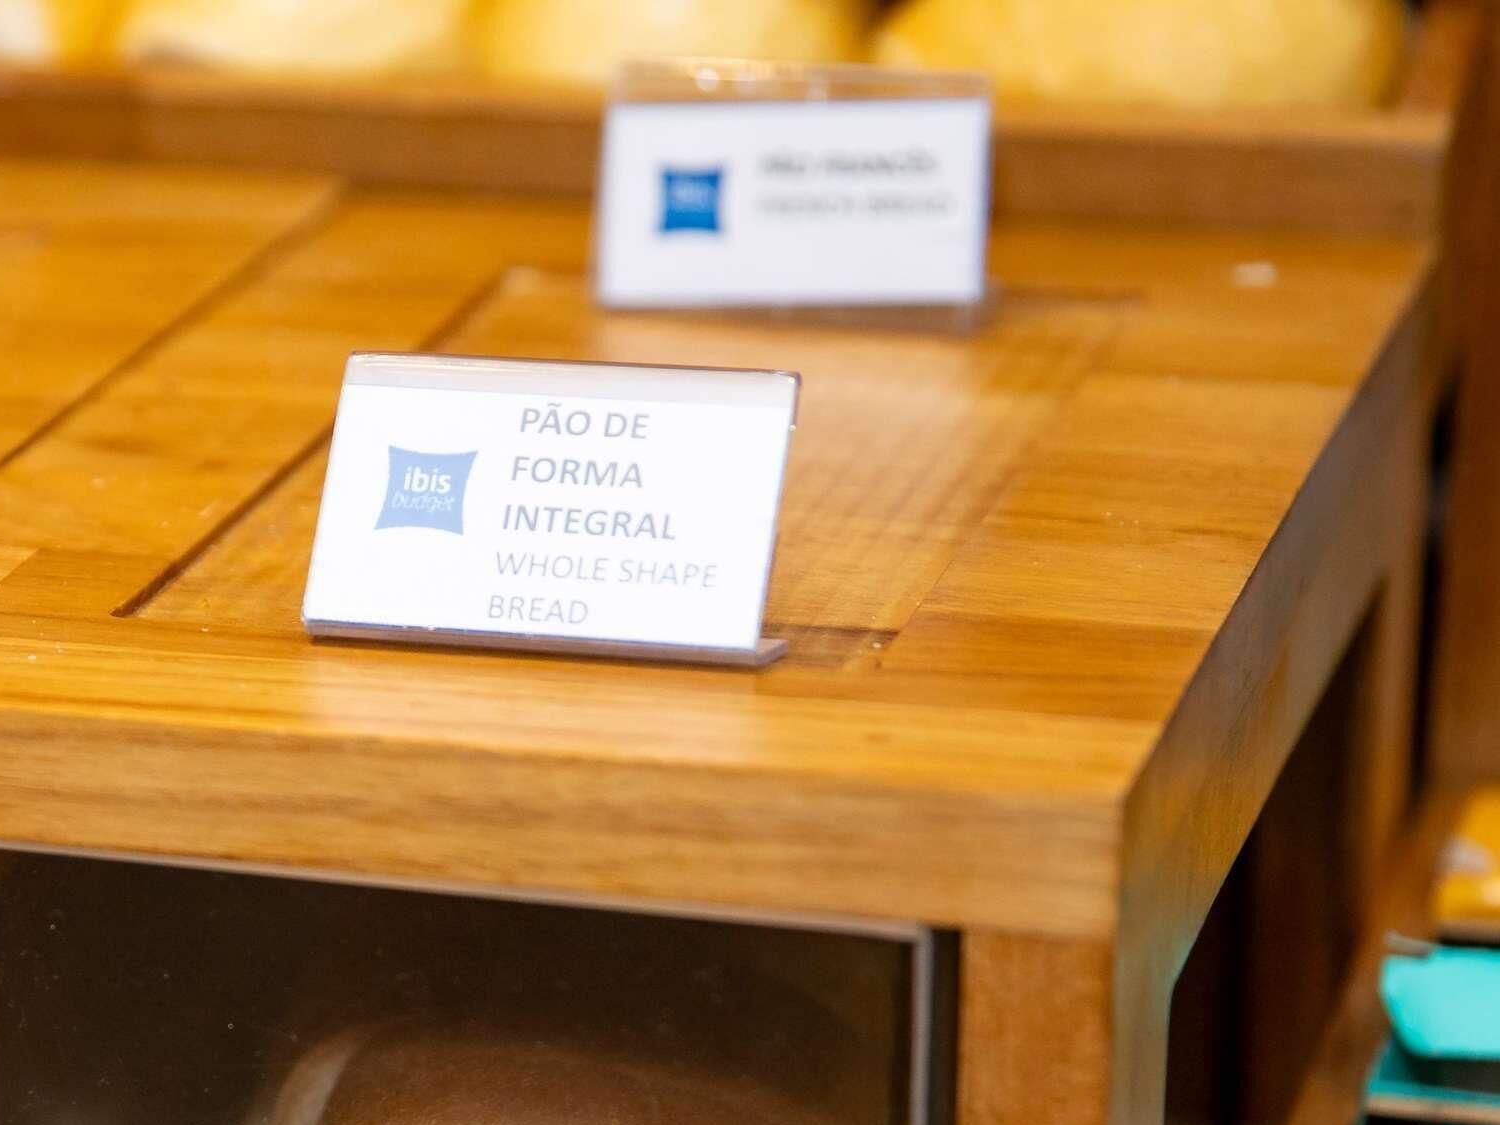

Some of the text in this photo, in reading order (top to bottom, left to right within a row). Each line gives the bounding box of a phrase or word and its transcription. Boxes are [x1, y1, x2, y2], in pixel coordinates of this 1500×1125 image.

[519, 402, 650, 440] PÃO DE
[404, 466, 451, 494] ibis
[511, 456, 644, 489] FORMA
[502, 504, 676, 541] INTEGRAL
[496, 551, 718, 589] WHOLE SHAPE
[487, 594, 590, 625] BREAD
